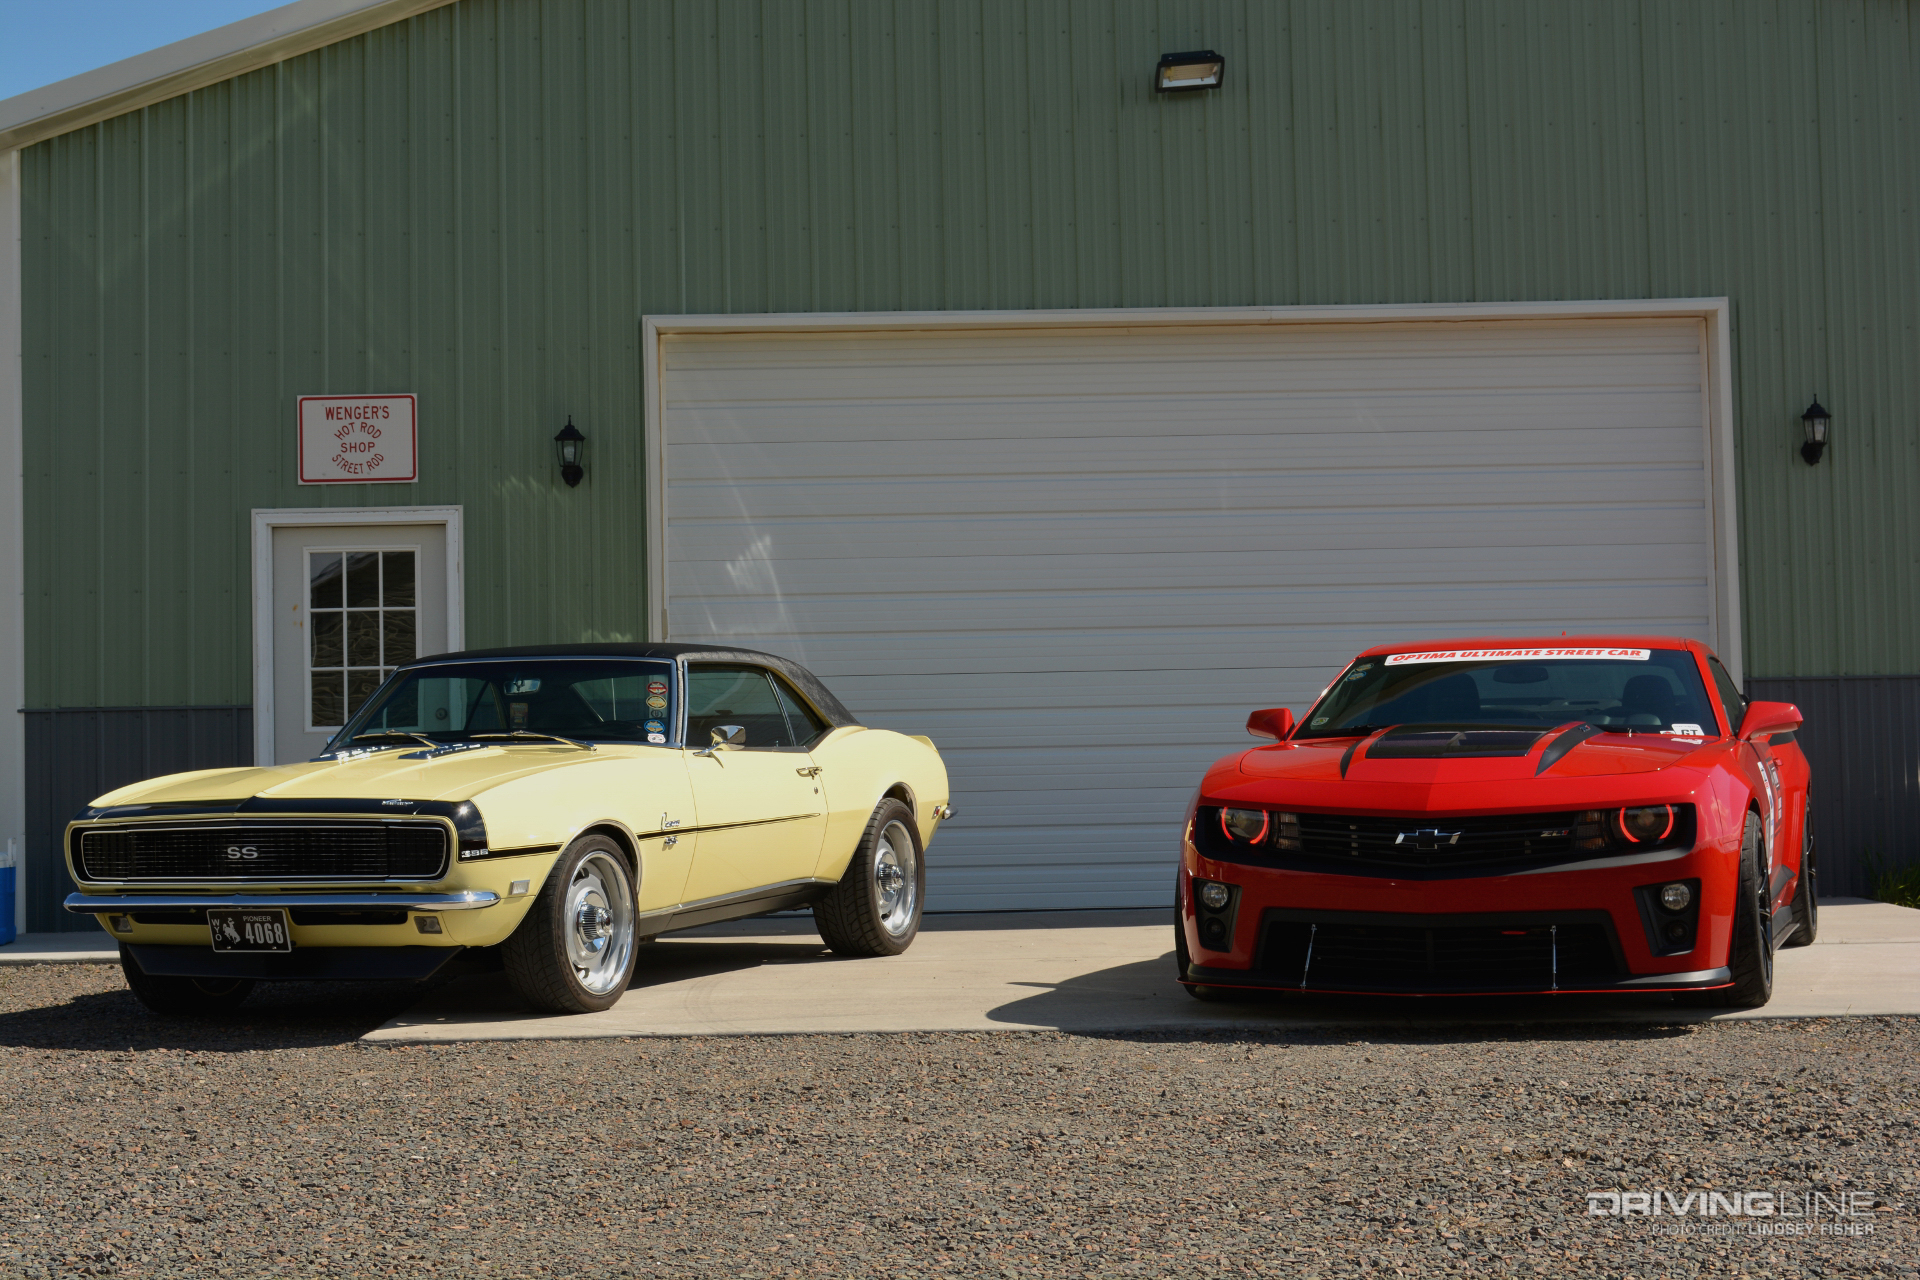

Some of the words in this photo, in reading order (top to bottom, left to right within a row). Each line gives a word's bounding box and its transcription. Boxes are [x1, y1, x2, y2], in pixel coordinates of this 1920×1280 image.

[325, 405, 390, 420] WENGER'S
[333, 421, 355, 440] HOT
[360, 421, 382, 439] ROD
[340, 441, 375, 453] SHOP
[331, 454, 364, 474] STREET
[365, 453, 384, 472] ROD
[1392, 652, 1457, 662] OPTIMA
[1460, 649, 1543, 658] ULTIMATE
[1607, 649, 1642, 657] CAR
[227, 846, 258, 859] SS
[245, 922, 284, 944] 4068
